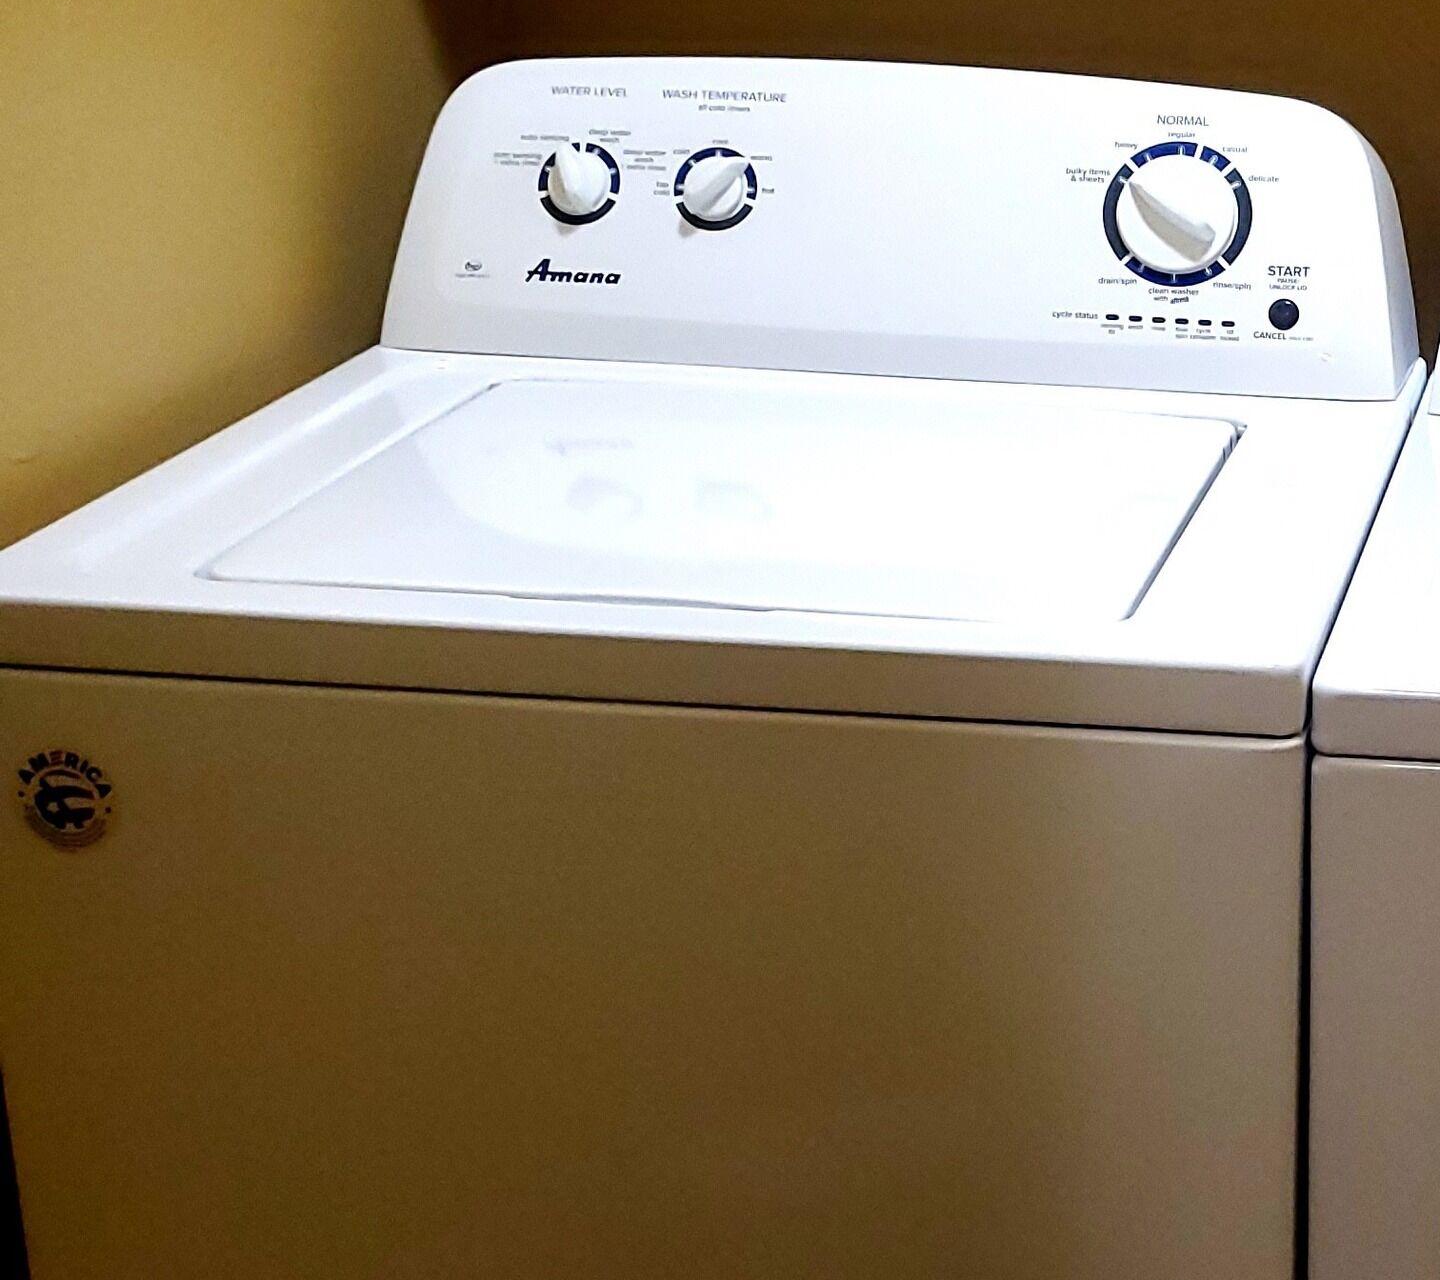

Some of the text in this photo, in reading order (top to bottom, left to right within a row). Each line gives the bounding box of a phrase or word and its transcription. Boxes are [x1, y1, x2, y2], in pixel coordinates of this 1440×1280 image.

[662, 89, 788, 103] WASH TEMPERATURE
[1157, 115, 1209, 127] NORMAL
[525, 258, 622, 284] Amana
[1267, 265, 1310, 278] START
[1253, 331, 1287, 340] CANCEL
[18, 750, 112, 799] AMERICA
